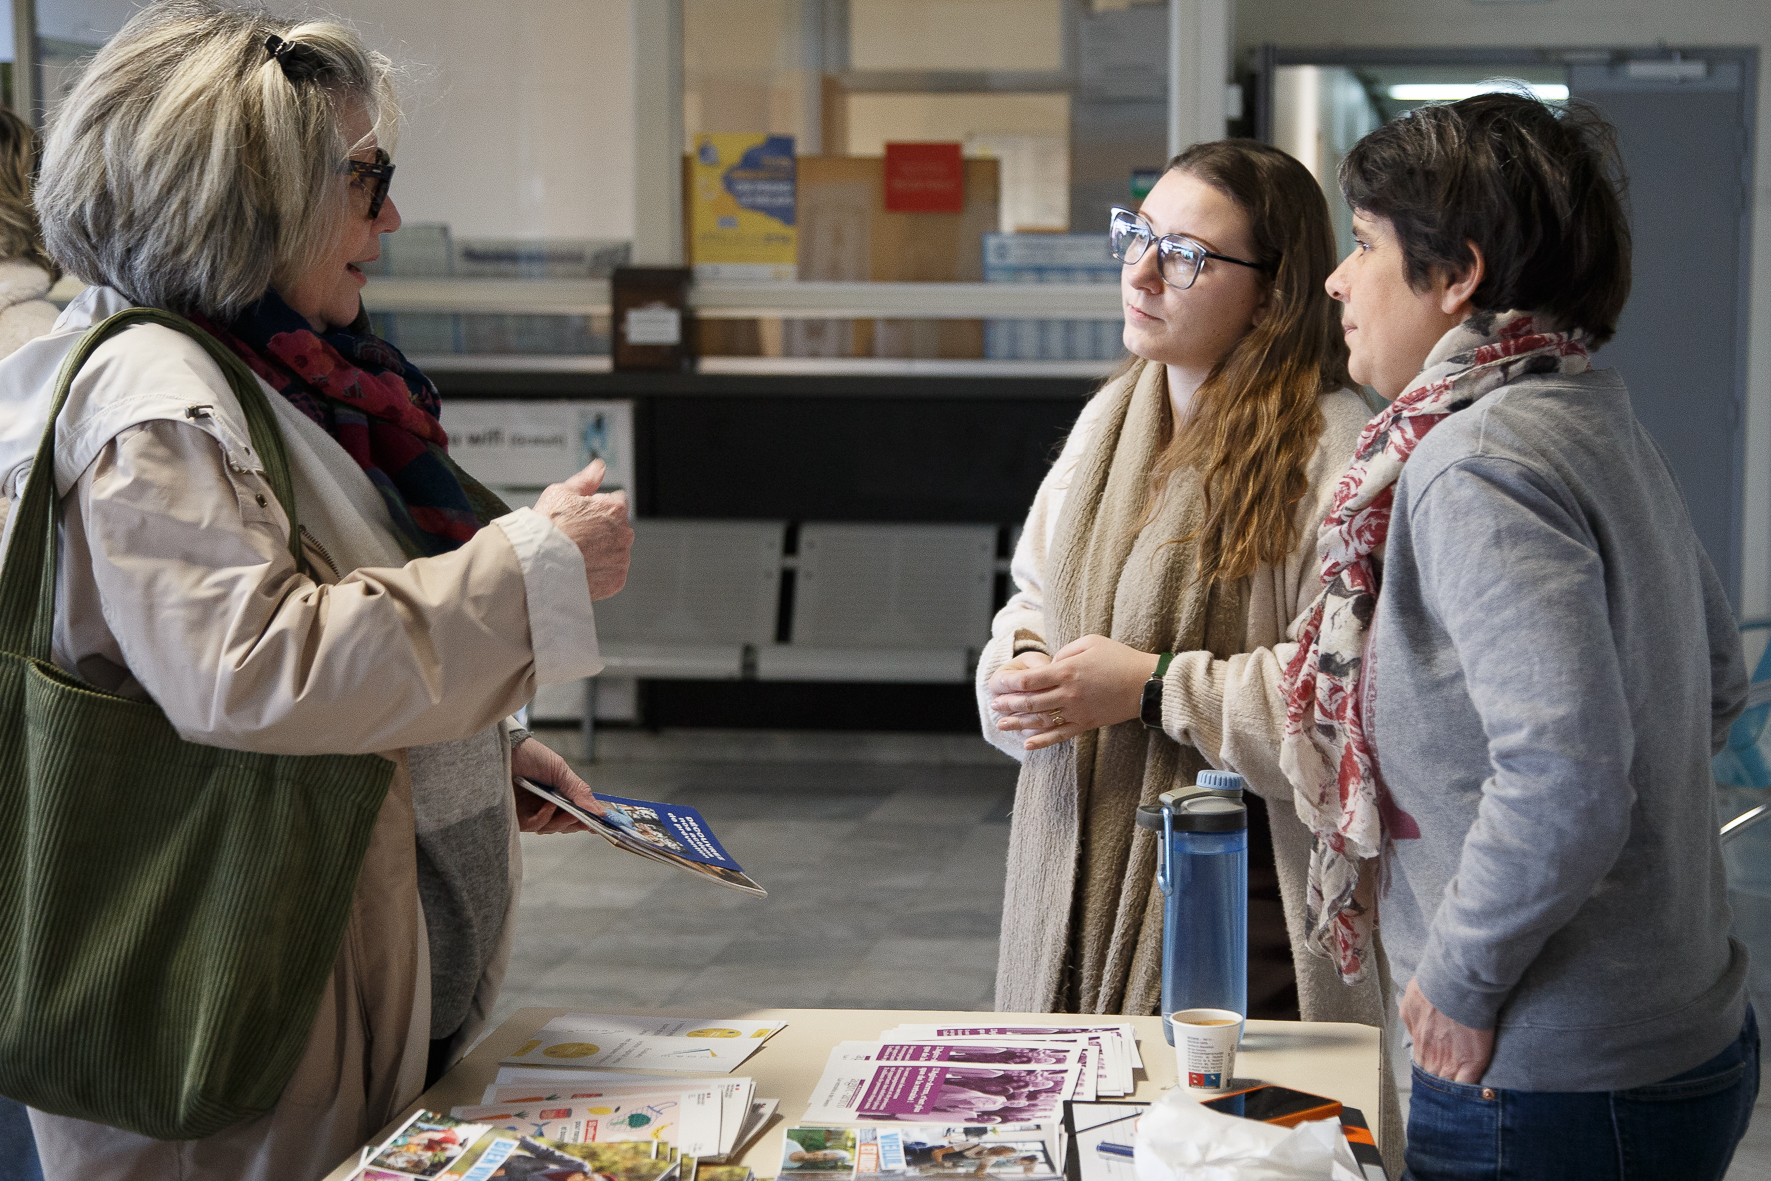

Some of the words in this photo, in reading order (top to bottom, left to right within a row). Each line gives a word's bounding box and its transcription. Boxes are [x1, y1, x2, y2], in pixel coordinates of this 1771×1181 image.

[667, 812, 678, 823] de
[673, 823, 710, 859] prévention
[685, 816, 726, 861] DÉCOUVREZ
